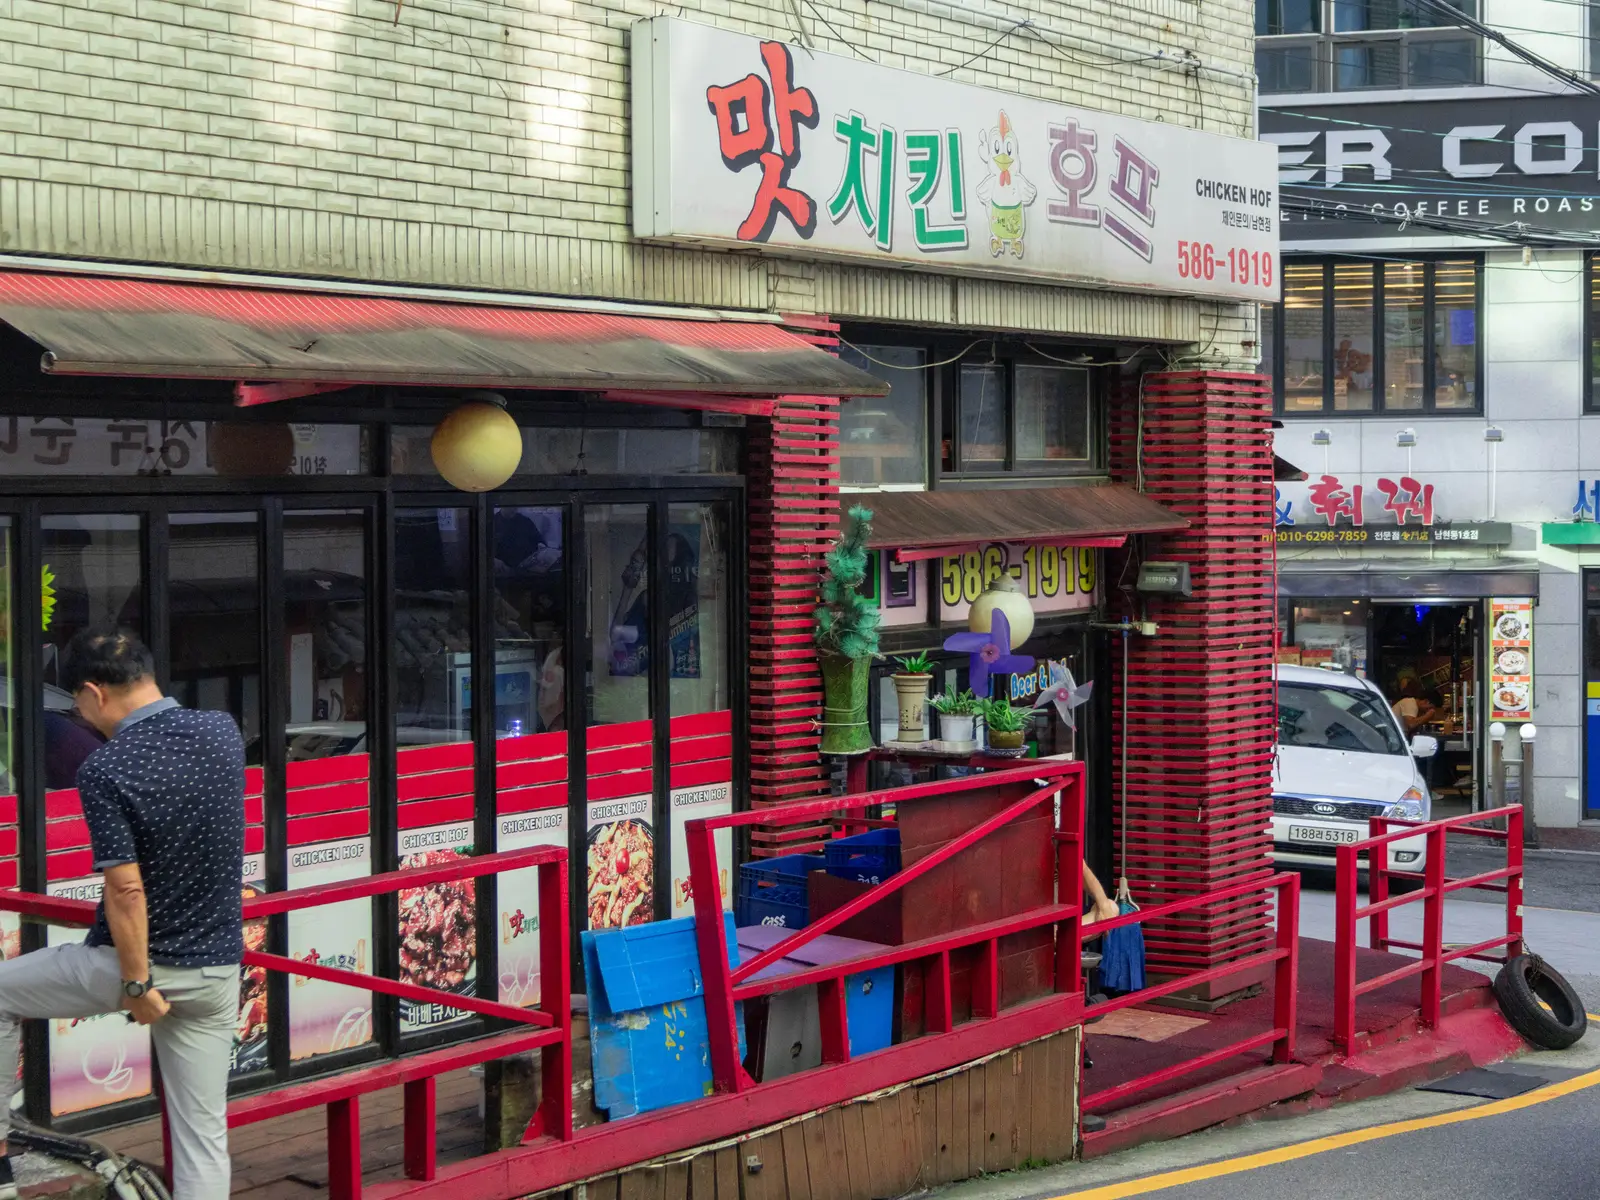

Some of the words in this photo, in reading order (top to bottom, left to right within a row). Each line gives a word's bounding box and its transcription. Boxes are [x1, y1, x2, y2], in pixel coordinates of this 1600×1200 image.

[1442, 120, 1600, 180] CO
[1047, 118, 1160, 264] 호프
[1196, 179, 1246, 204] CHICKEN
[1250, 188, 1272, 208] HOF
[1514, 197, 1594, 213] ROAS
[1177, 240, 1272, 287] 586-1919
[942, 546, 1096, 606] 586-1919
[1010, 673, 1037, 700] Beer
[674, 791, 709, 806] CHICKEN
[711, 787, 727, 803] HOF
[591, 803, 628, 820] CHICKEN
[630, 800, 647, 816] HOF
[501, 818, 542, 834] CHICKEN
[544, 814, 562, 830] HOF
[402, 830, 446, 849] CHICKEN
[448, 828, 469, 844] HOF
[292, 848, 340, 868] CHICKEN
[342, 843, 365, 860] HOF
[242, 860, 258, 876] OF
[53, 882, 105, 900] CHICKE
